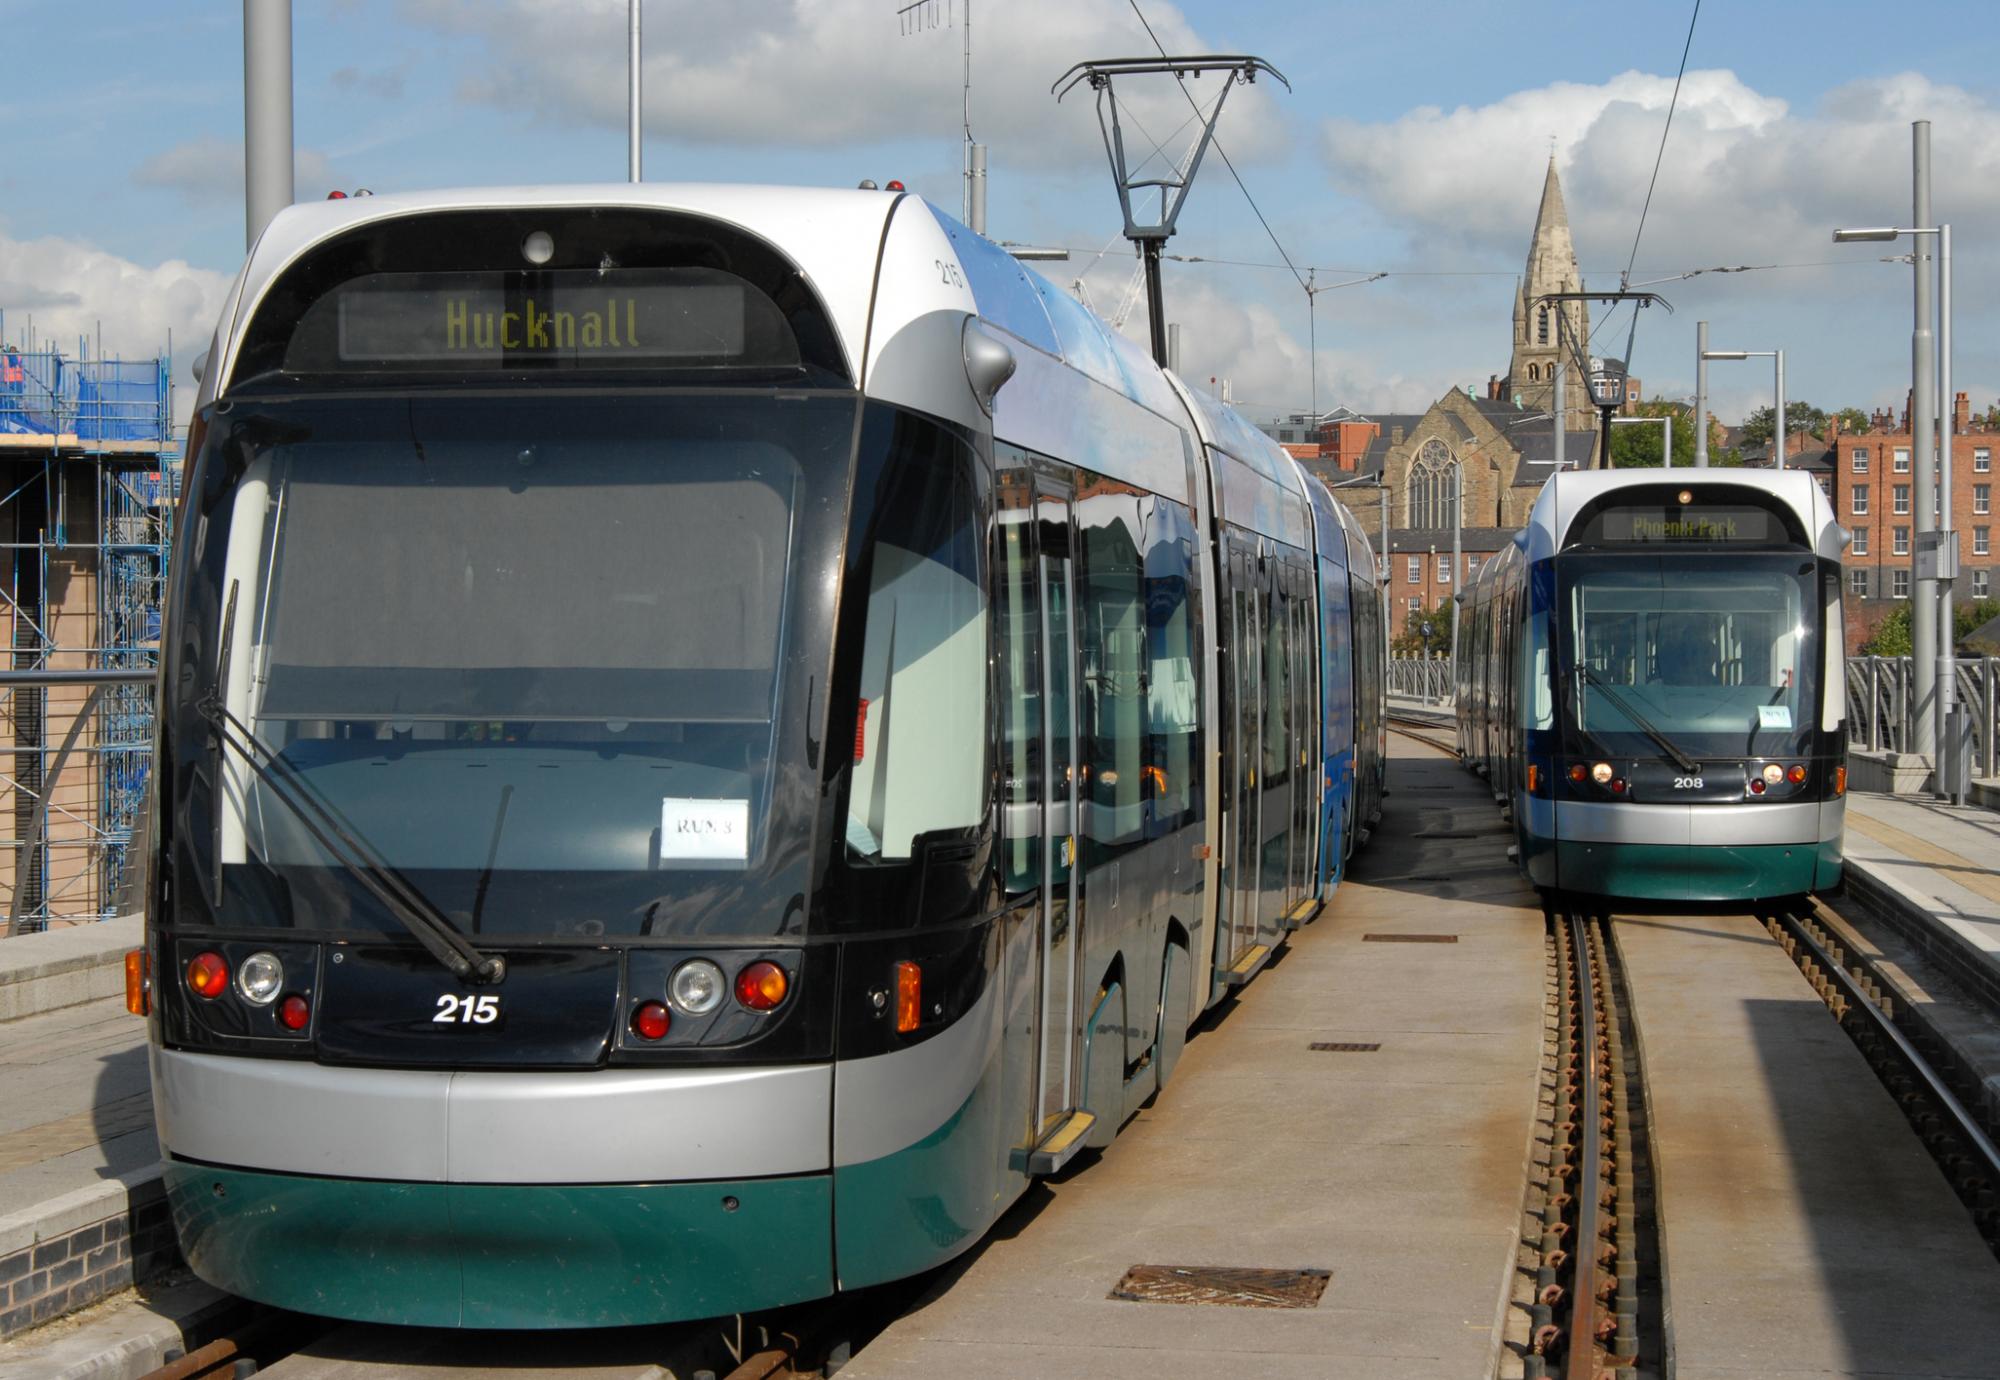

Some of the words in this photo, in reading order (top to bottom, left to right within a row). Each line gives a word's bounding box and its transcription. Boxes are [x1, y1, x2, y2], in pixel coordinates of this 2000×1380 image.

[935, 259, 963, 289] 215
[446, 299, 641, 350] Hucknall
[1632, 516, 1694, 537] Phoenix
[1699, 516, 1737, 537] Park
[1673, 777, 1704, 789] 208
[432, 994, 499, 1024] 215
